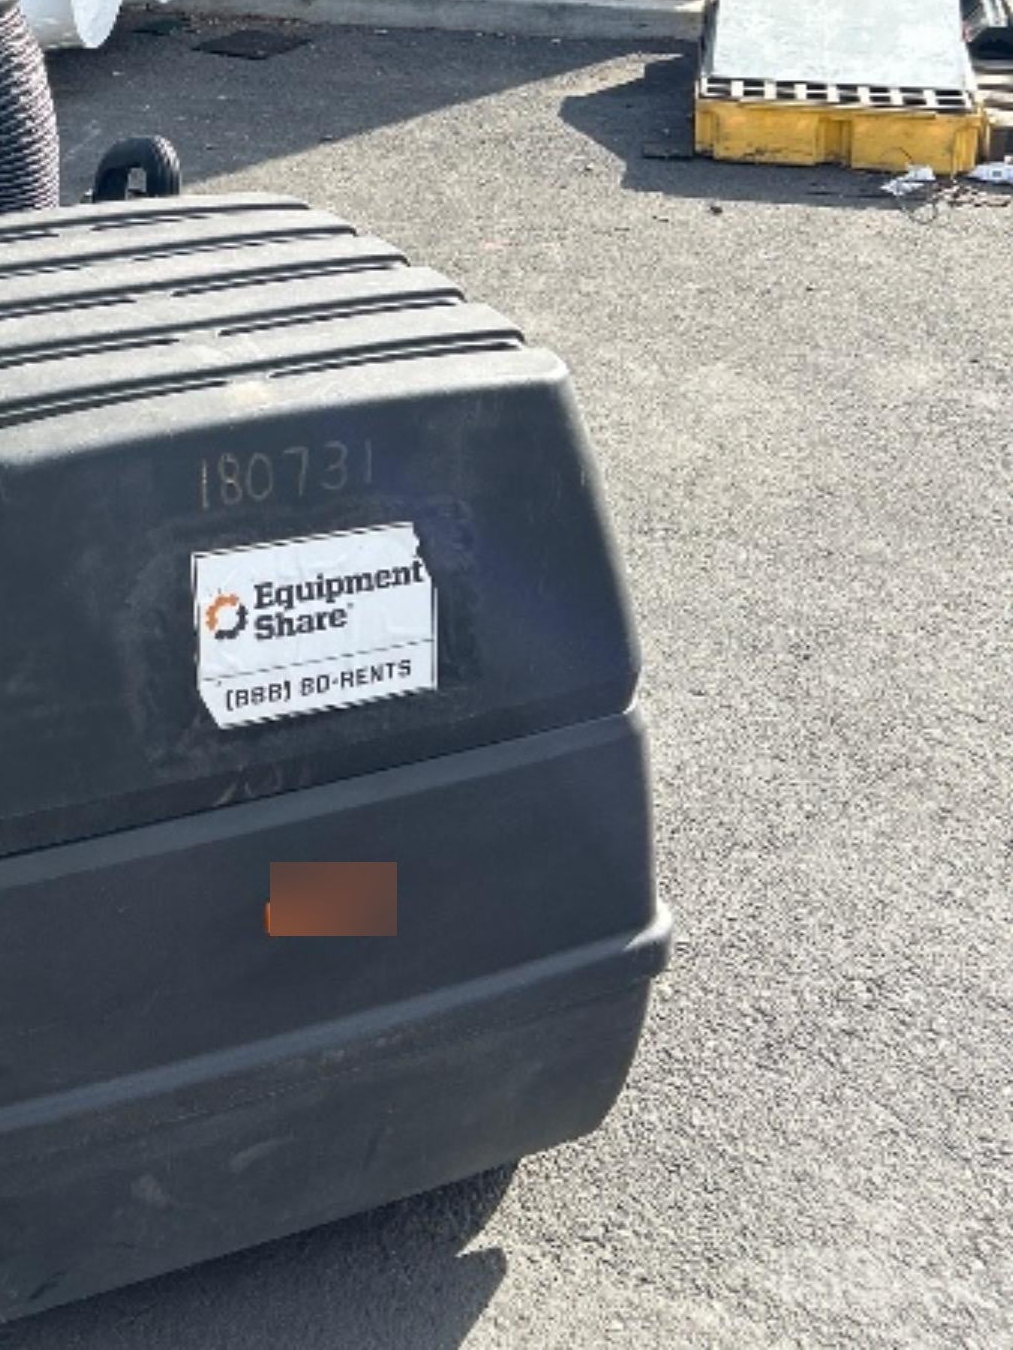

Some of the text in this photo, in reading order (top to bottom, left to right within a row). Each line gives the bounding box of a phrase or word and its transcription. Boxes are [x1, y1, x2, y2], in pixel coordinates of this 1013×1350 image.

[201, 439, 374, 509] 180731
[253, 559, 424, 610] Equipment
[253, 606, 348, 641] Share
